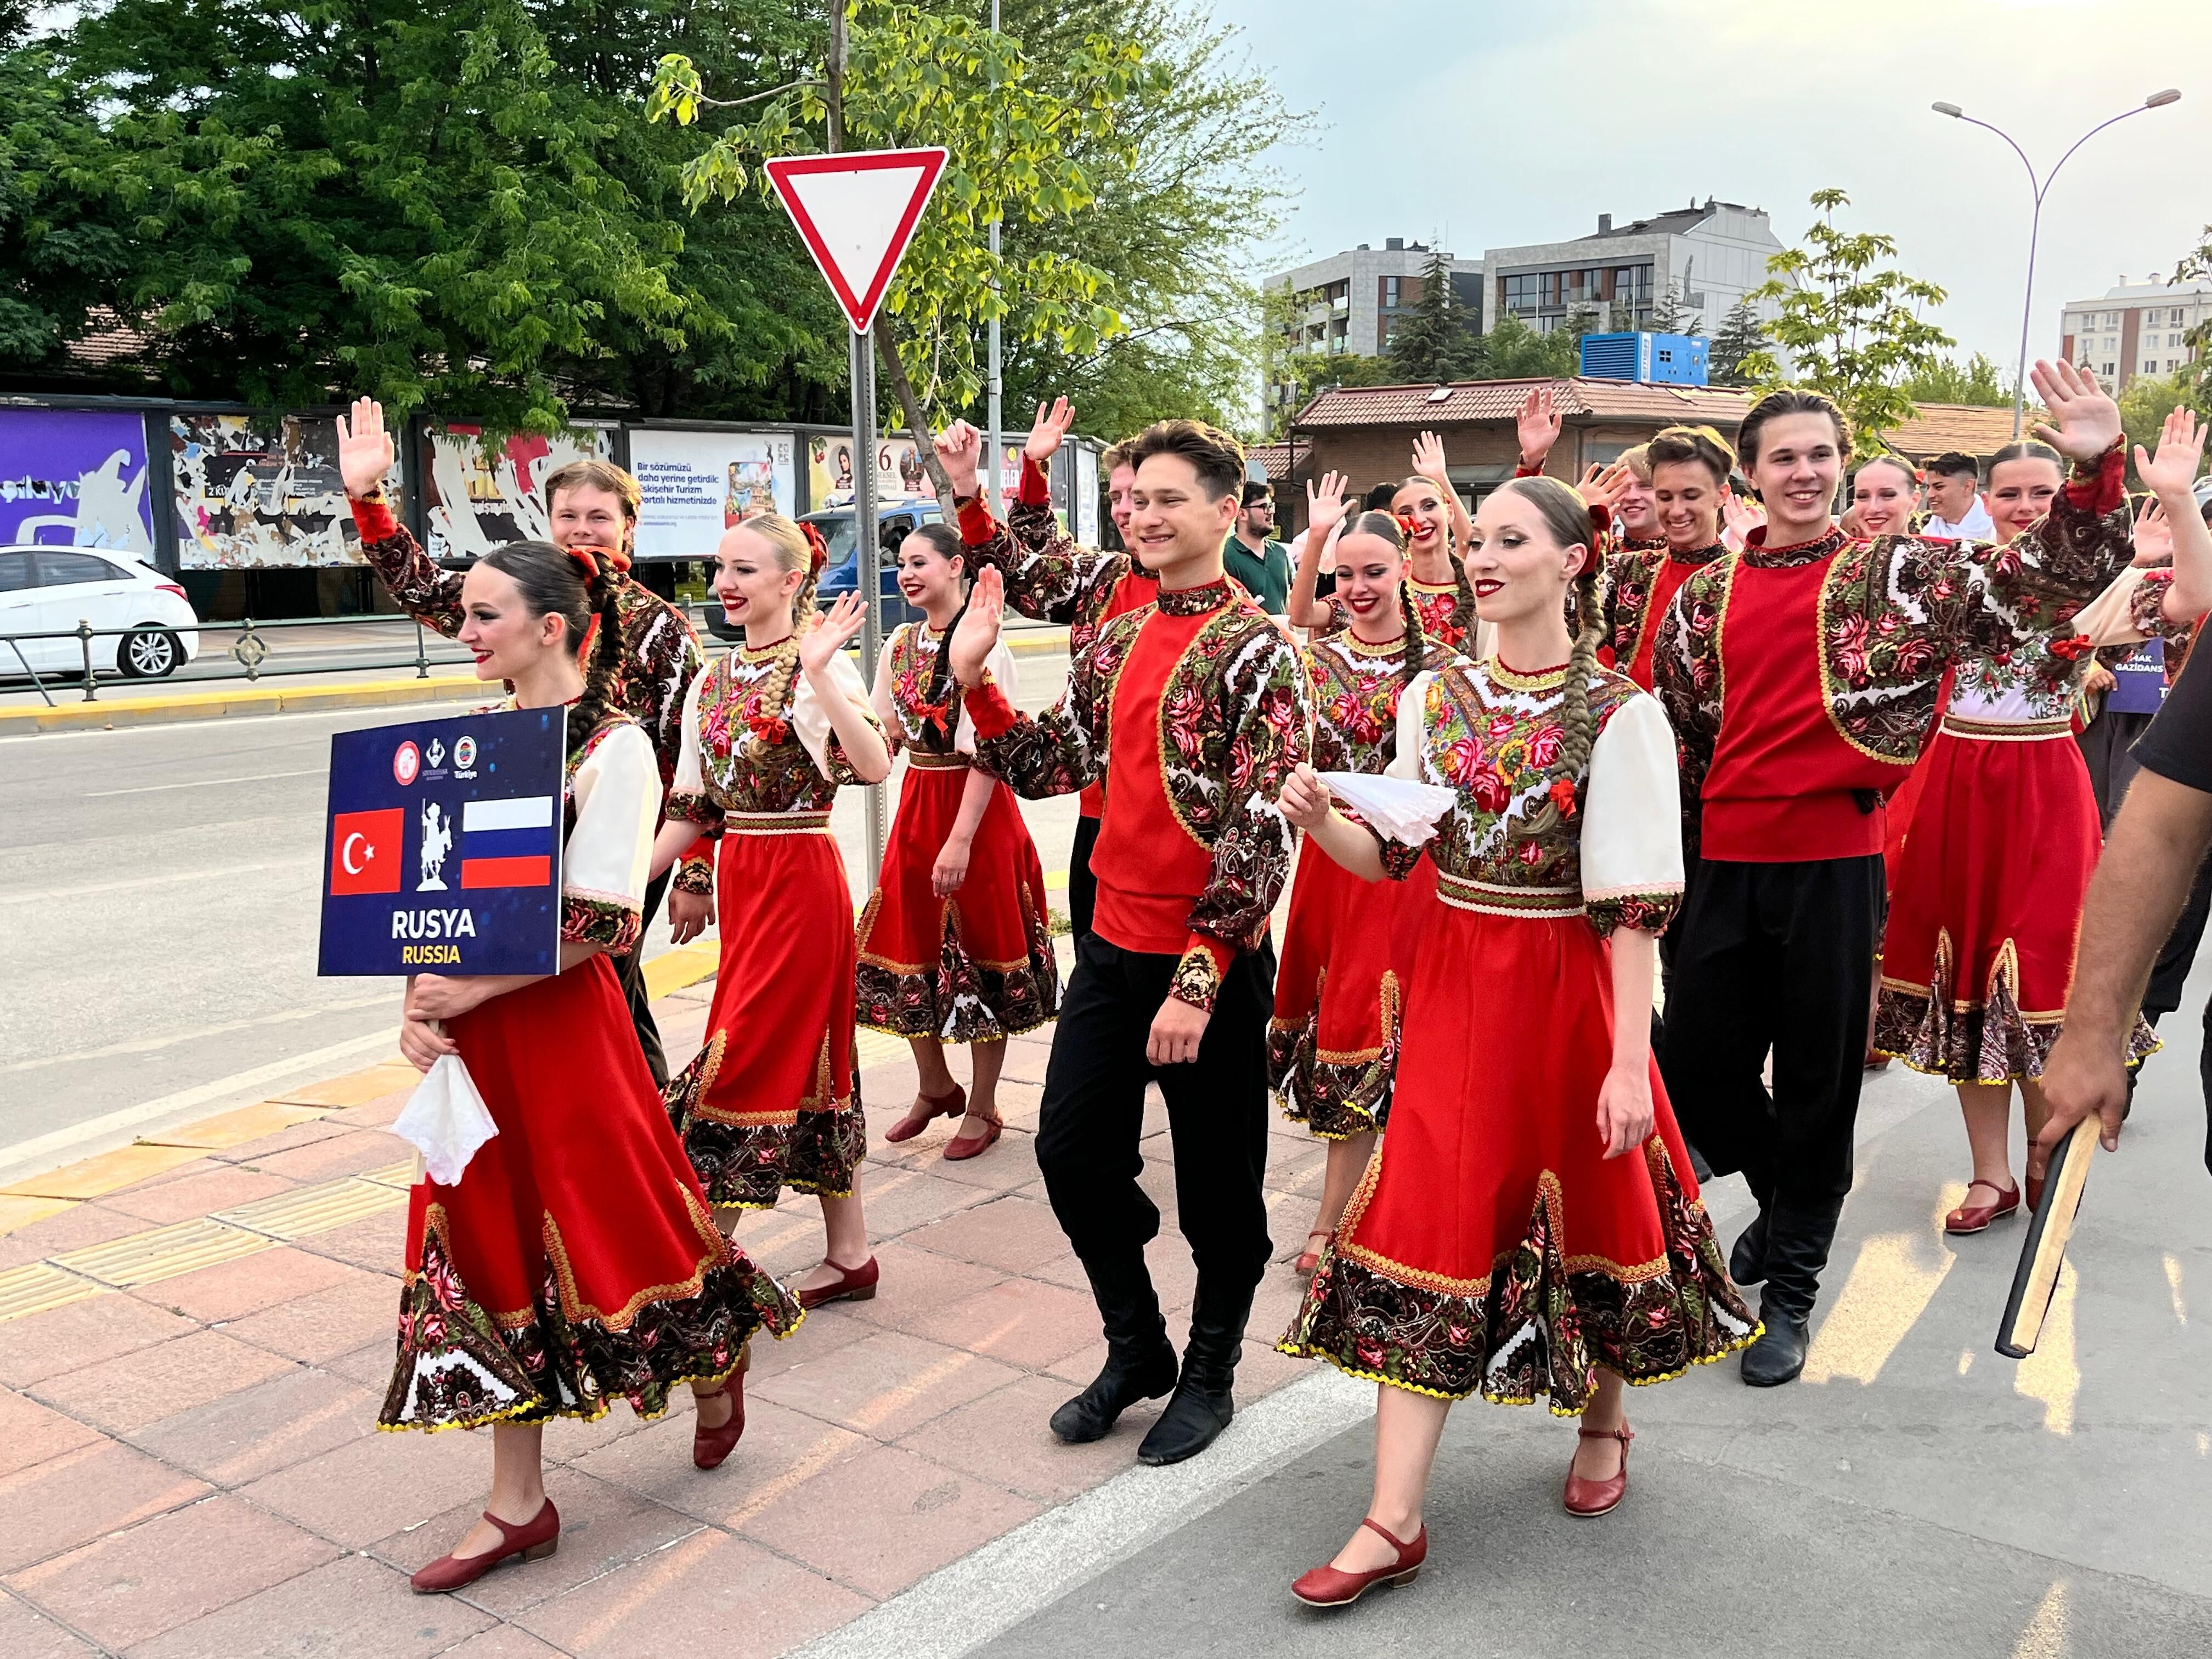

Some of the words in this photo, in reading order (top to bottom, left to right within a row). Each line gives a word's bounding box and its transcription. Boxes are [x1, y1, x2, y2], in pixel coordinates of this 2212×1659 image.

[637, 462, 648, 471] Bir
[650, 462, 692, 472] sözümüzü
[638, 473, 659, 482] daha
[661, 475, 685, 483] yerine
[641, 484, 674, 494] skişehir
[676, 486, 702, 494] Turizm
[667, 495, 717, 505] hizmetinizde
[2115, 662, 2164, 673] GAZİDANS
[392, 909, 476, 939] RUSYA
[402, 945, 461, 964] RUSSIA
